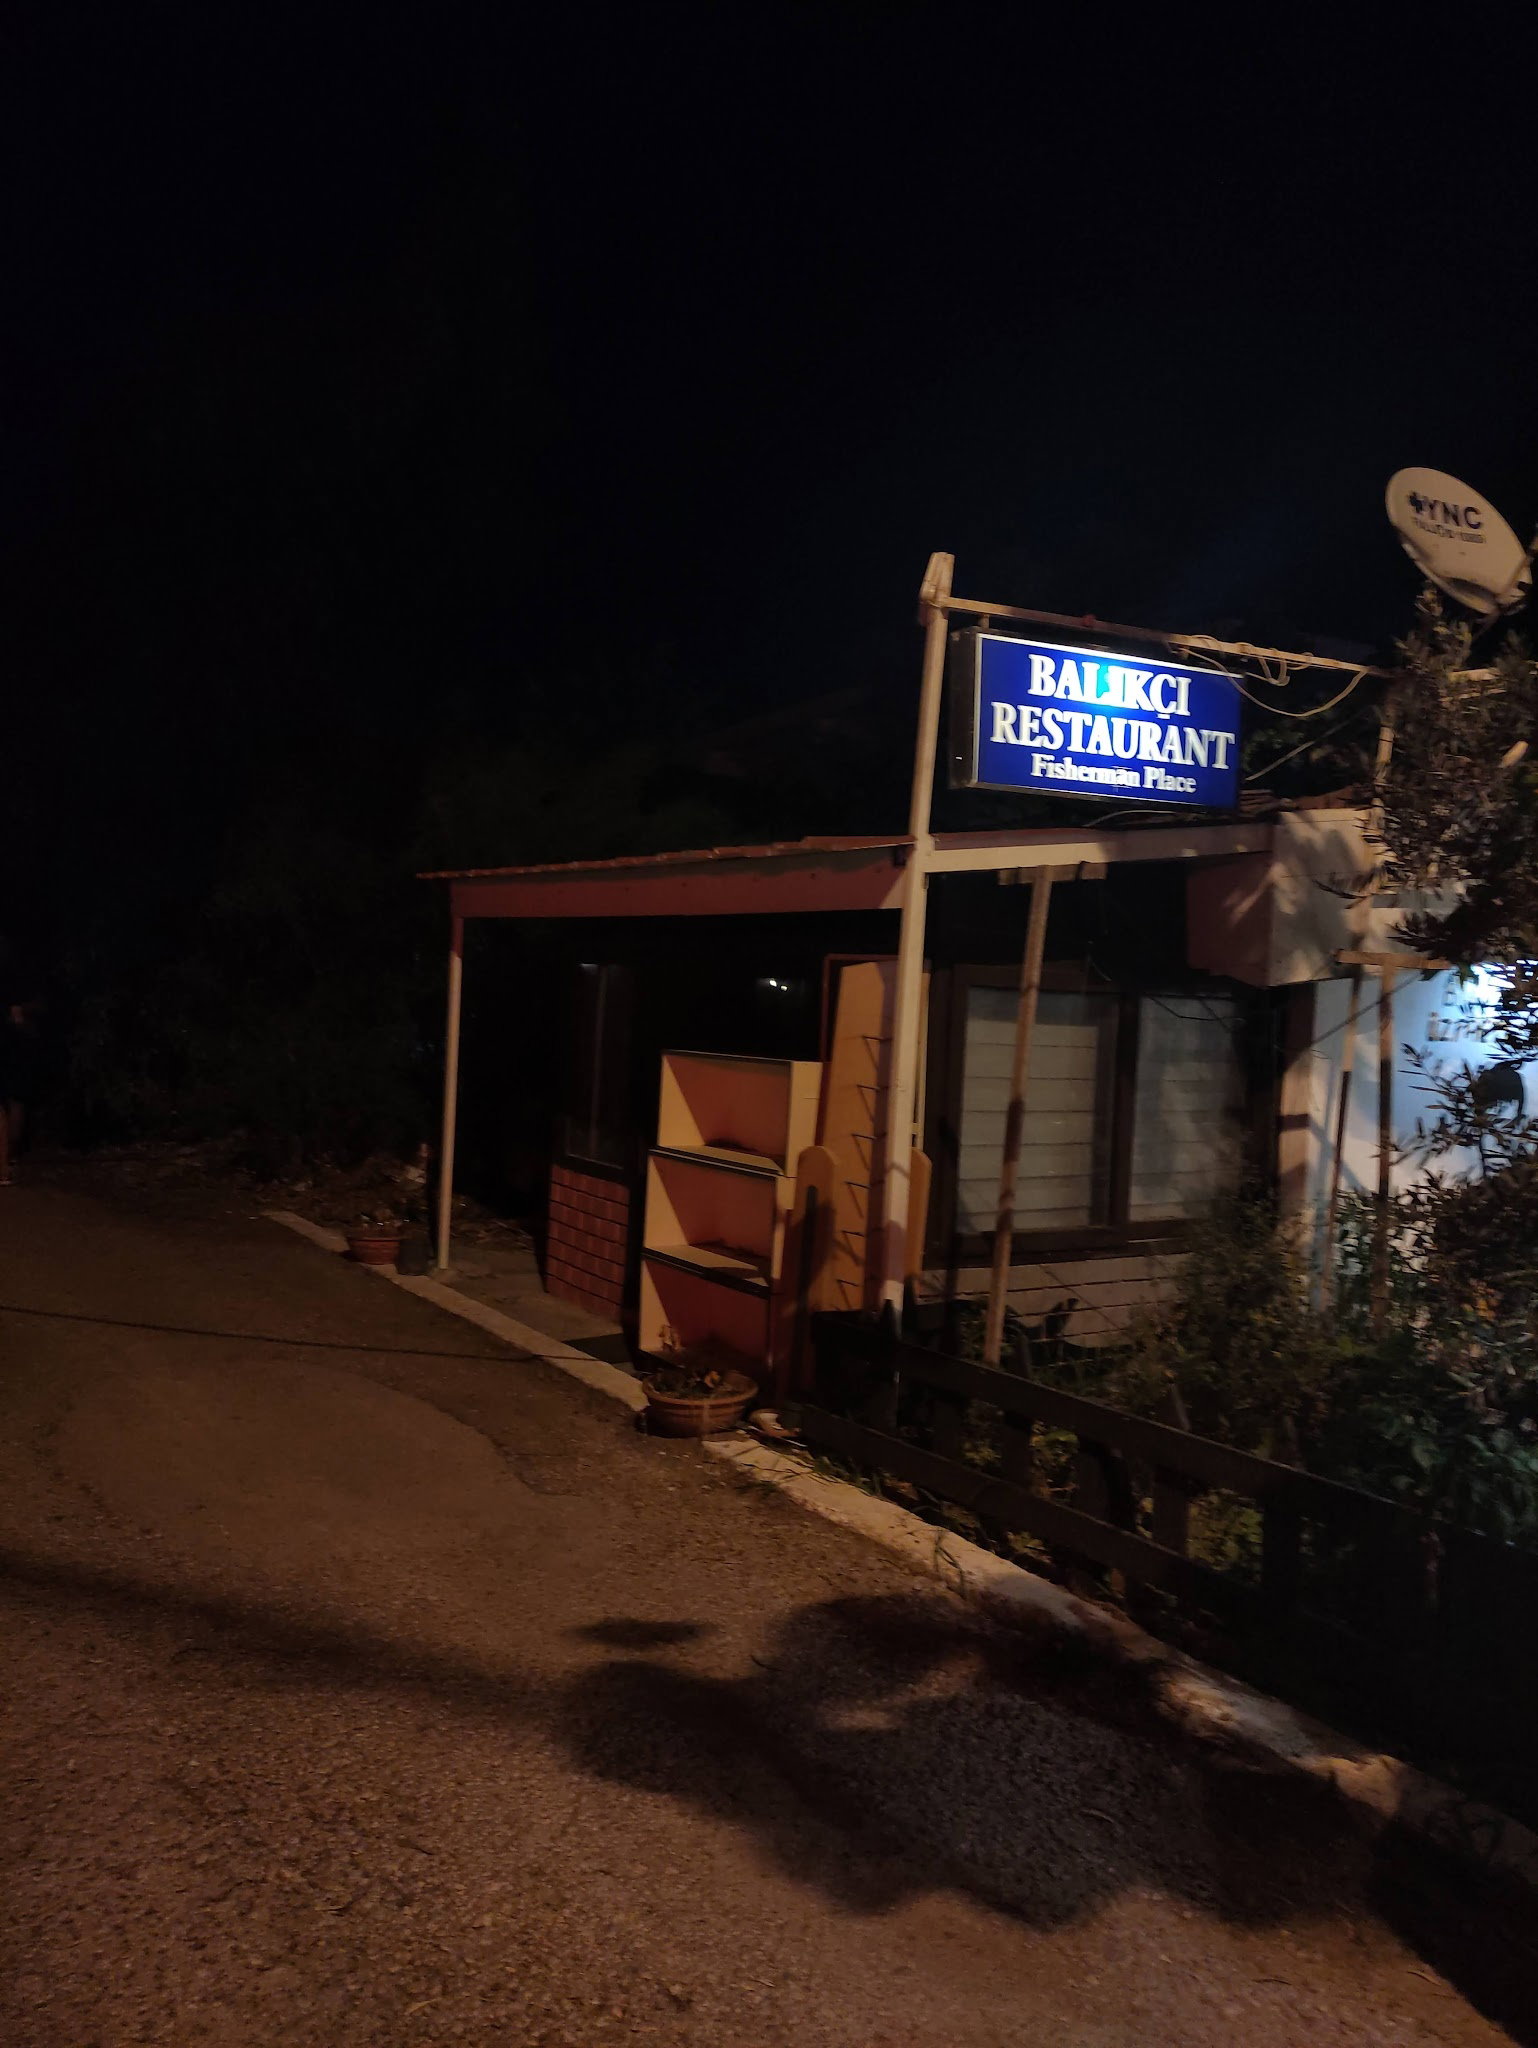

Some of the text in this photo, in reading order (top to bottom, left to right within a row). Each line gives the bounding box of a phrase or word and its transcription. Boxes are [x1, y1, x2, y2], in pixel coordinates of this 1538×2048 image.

[1028, 654, 1191, 719] BALIKÇI
[990, 701, 1235, 769] RESTAURANT
[1031, 753, 1197, 793] Fisherman Place
